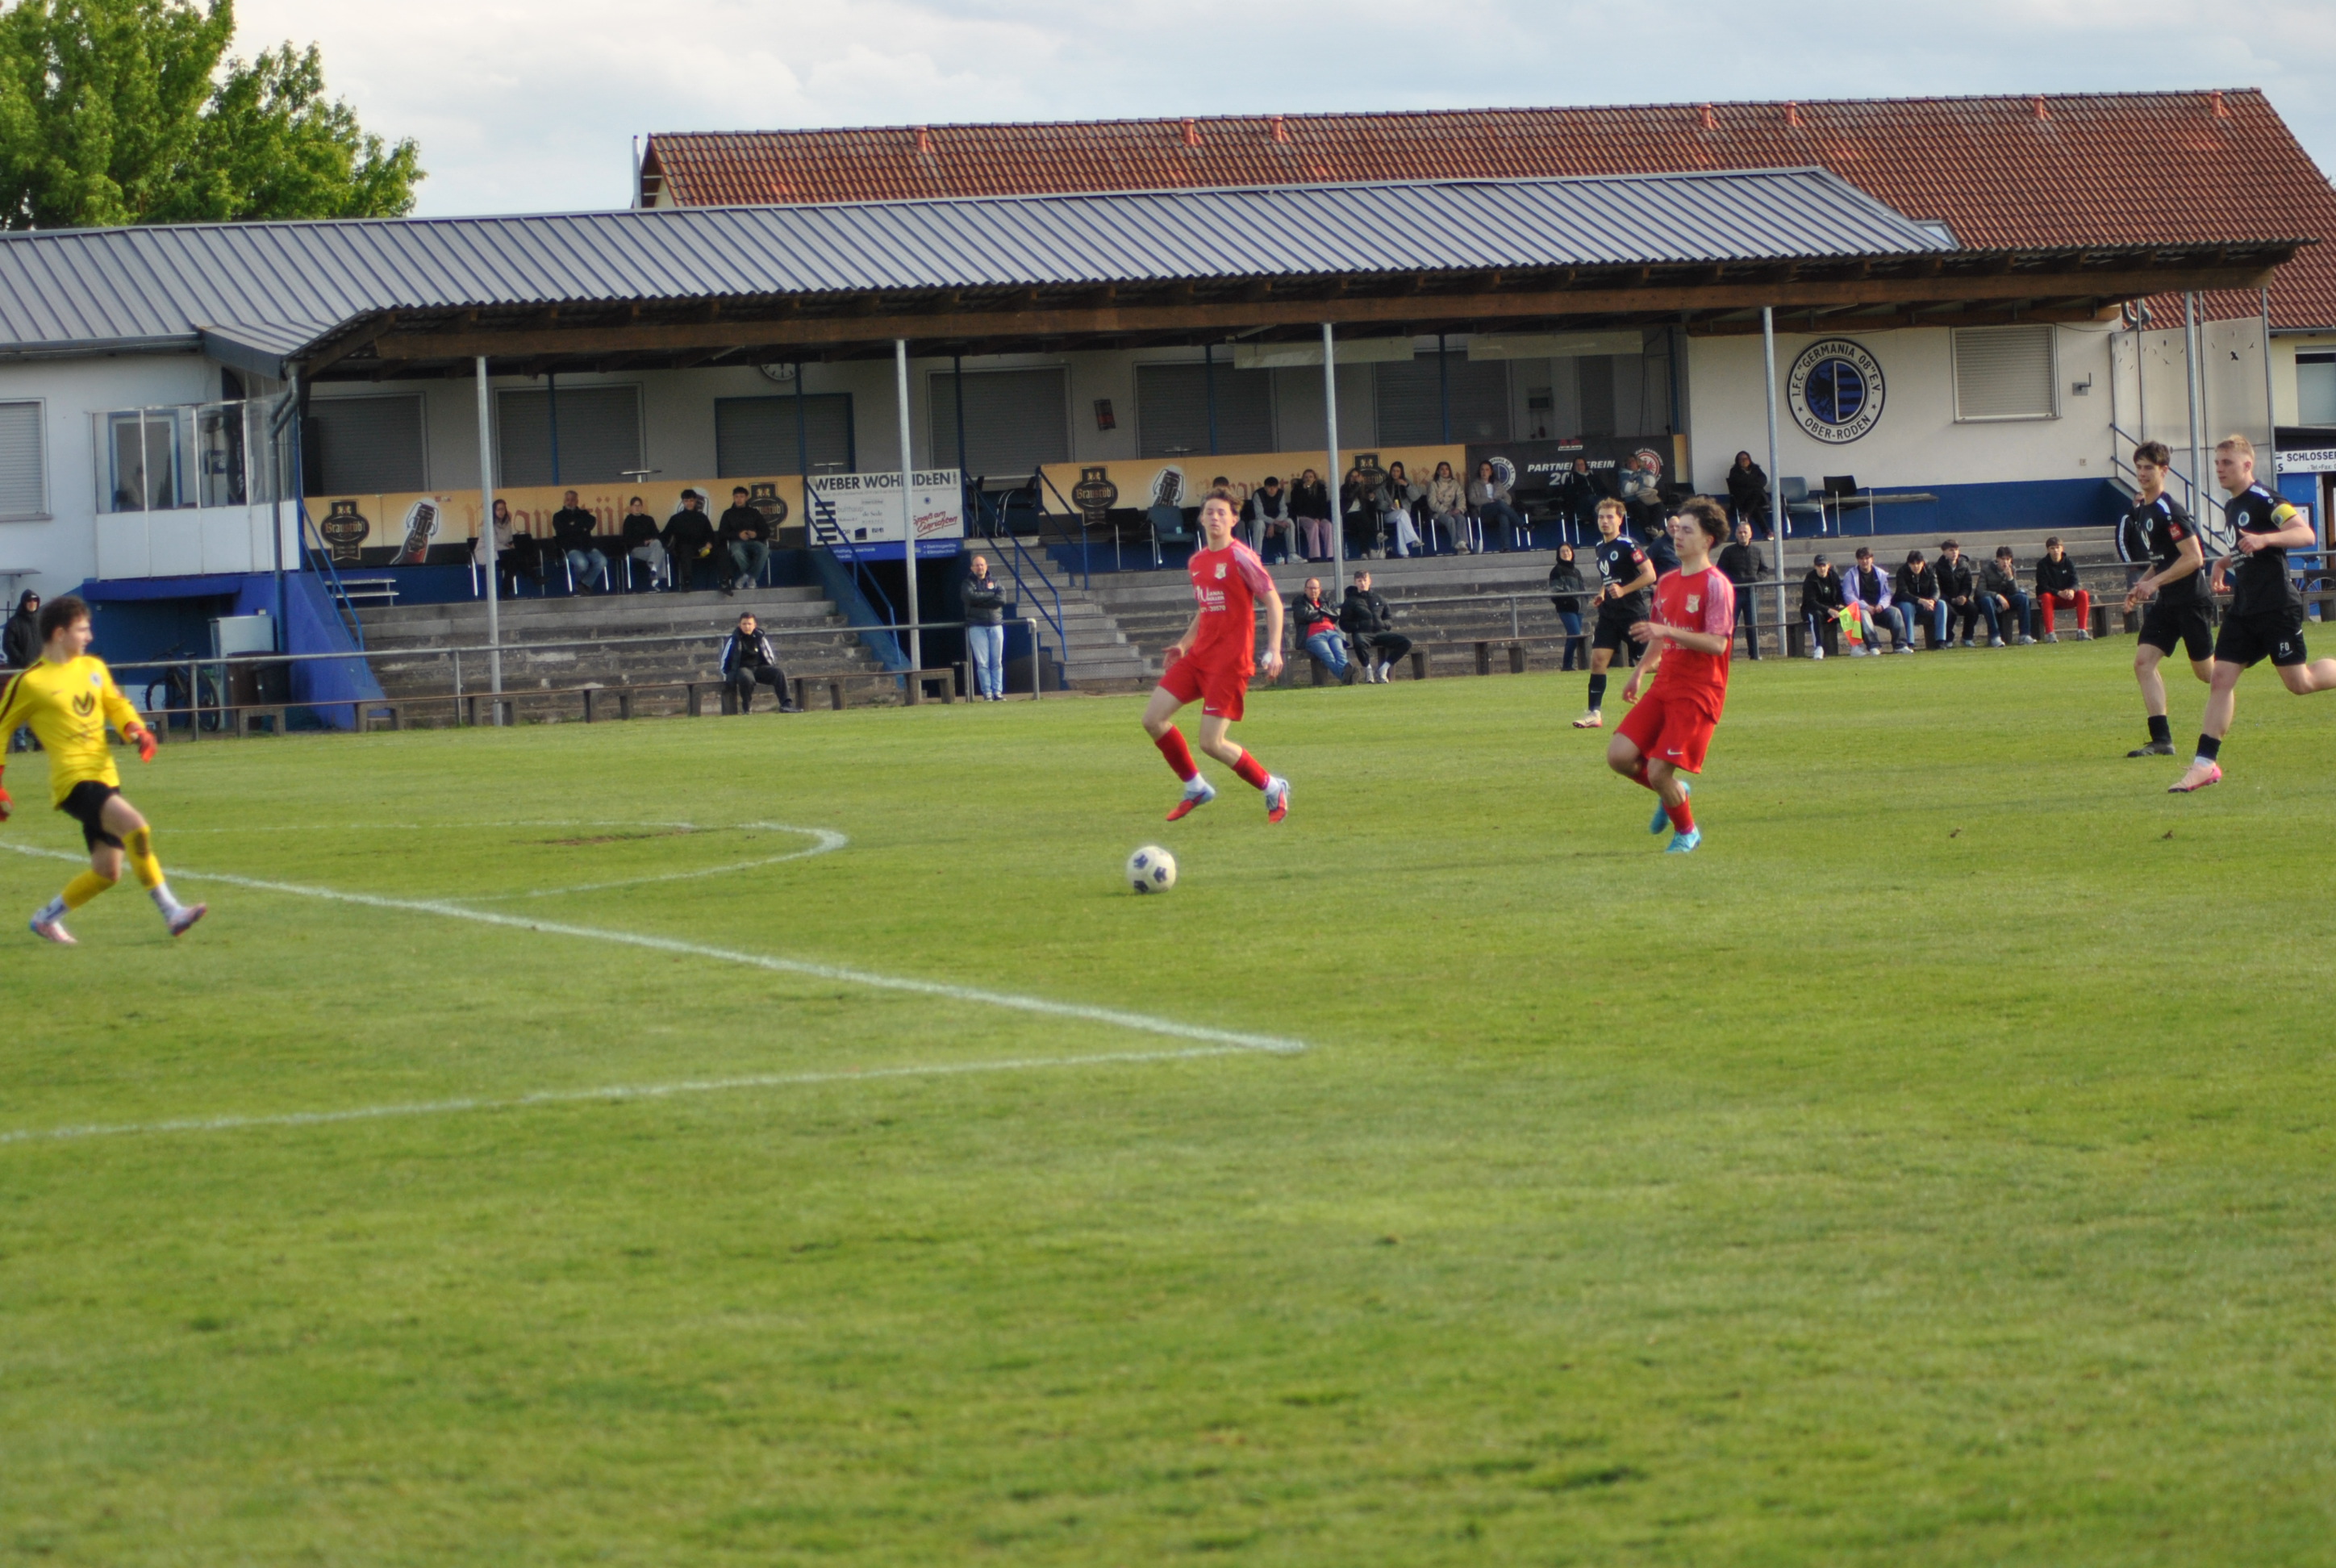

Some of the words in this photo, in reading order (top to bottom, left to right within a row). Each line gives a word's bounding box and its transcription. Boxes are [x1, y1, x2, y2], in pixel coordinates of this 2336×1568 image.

[1804, 415, 1871, 440] OBER-RODEN
[2286, 452, 2336, 462] SCHLOSSE
[1527, 460, 1616, 473] PARTNEREIN
[816, 477, 861, 491] WEBER
[863, 472, 951, 488] WOHIDEEN
